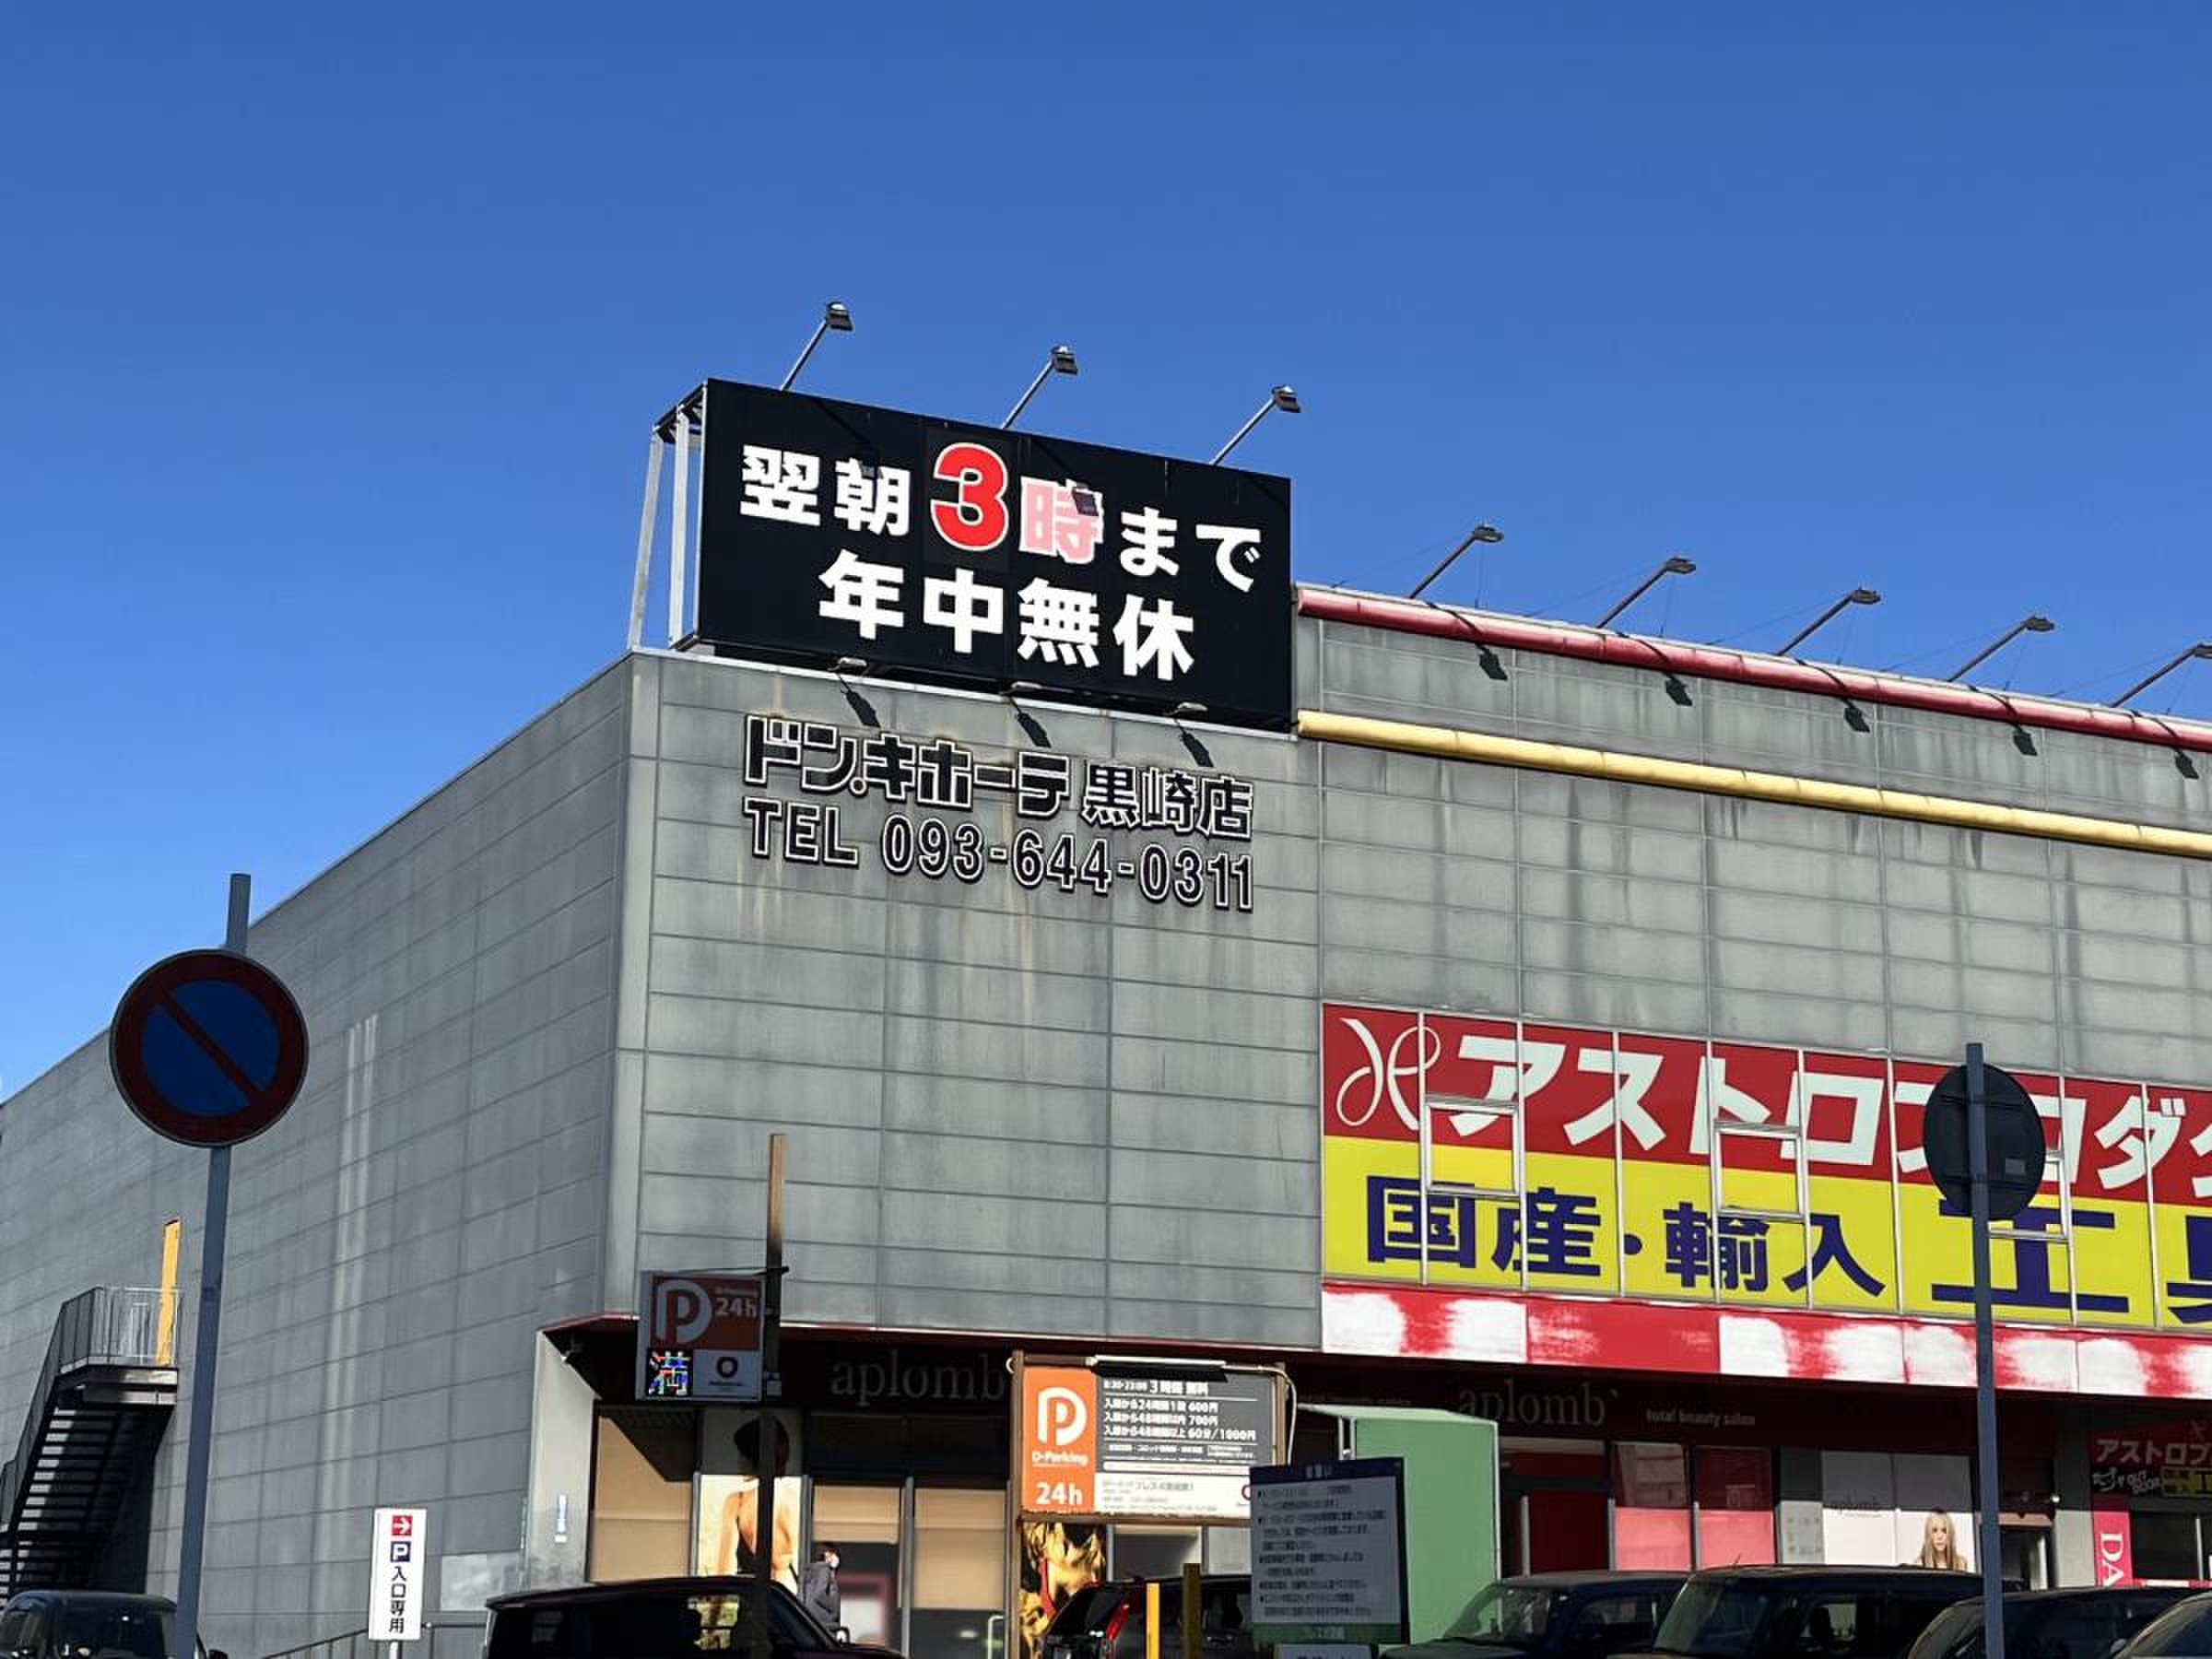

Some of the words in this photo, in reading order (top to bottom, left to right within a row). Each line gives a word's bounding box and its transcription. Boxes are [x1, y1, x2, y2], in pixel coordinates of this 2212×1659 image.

[740, 442, 1262, 593] 翌朝3時まで
[818, 549, 1194, 680] 年中無休
[743, 796, 859, 866] TEL
[881, 815, 1253, 911] 093-644-0311
[1035, 1481, 1083, 1505] 24h
[388, 1565, 407, 1634] 入口専用
